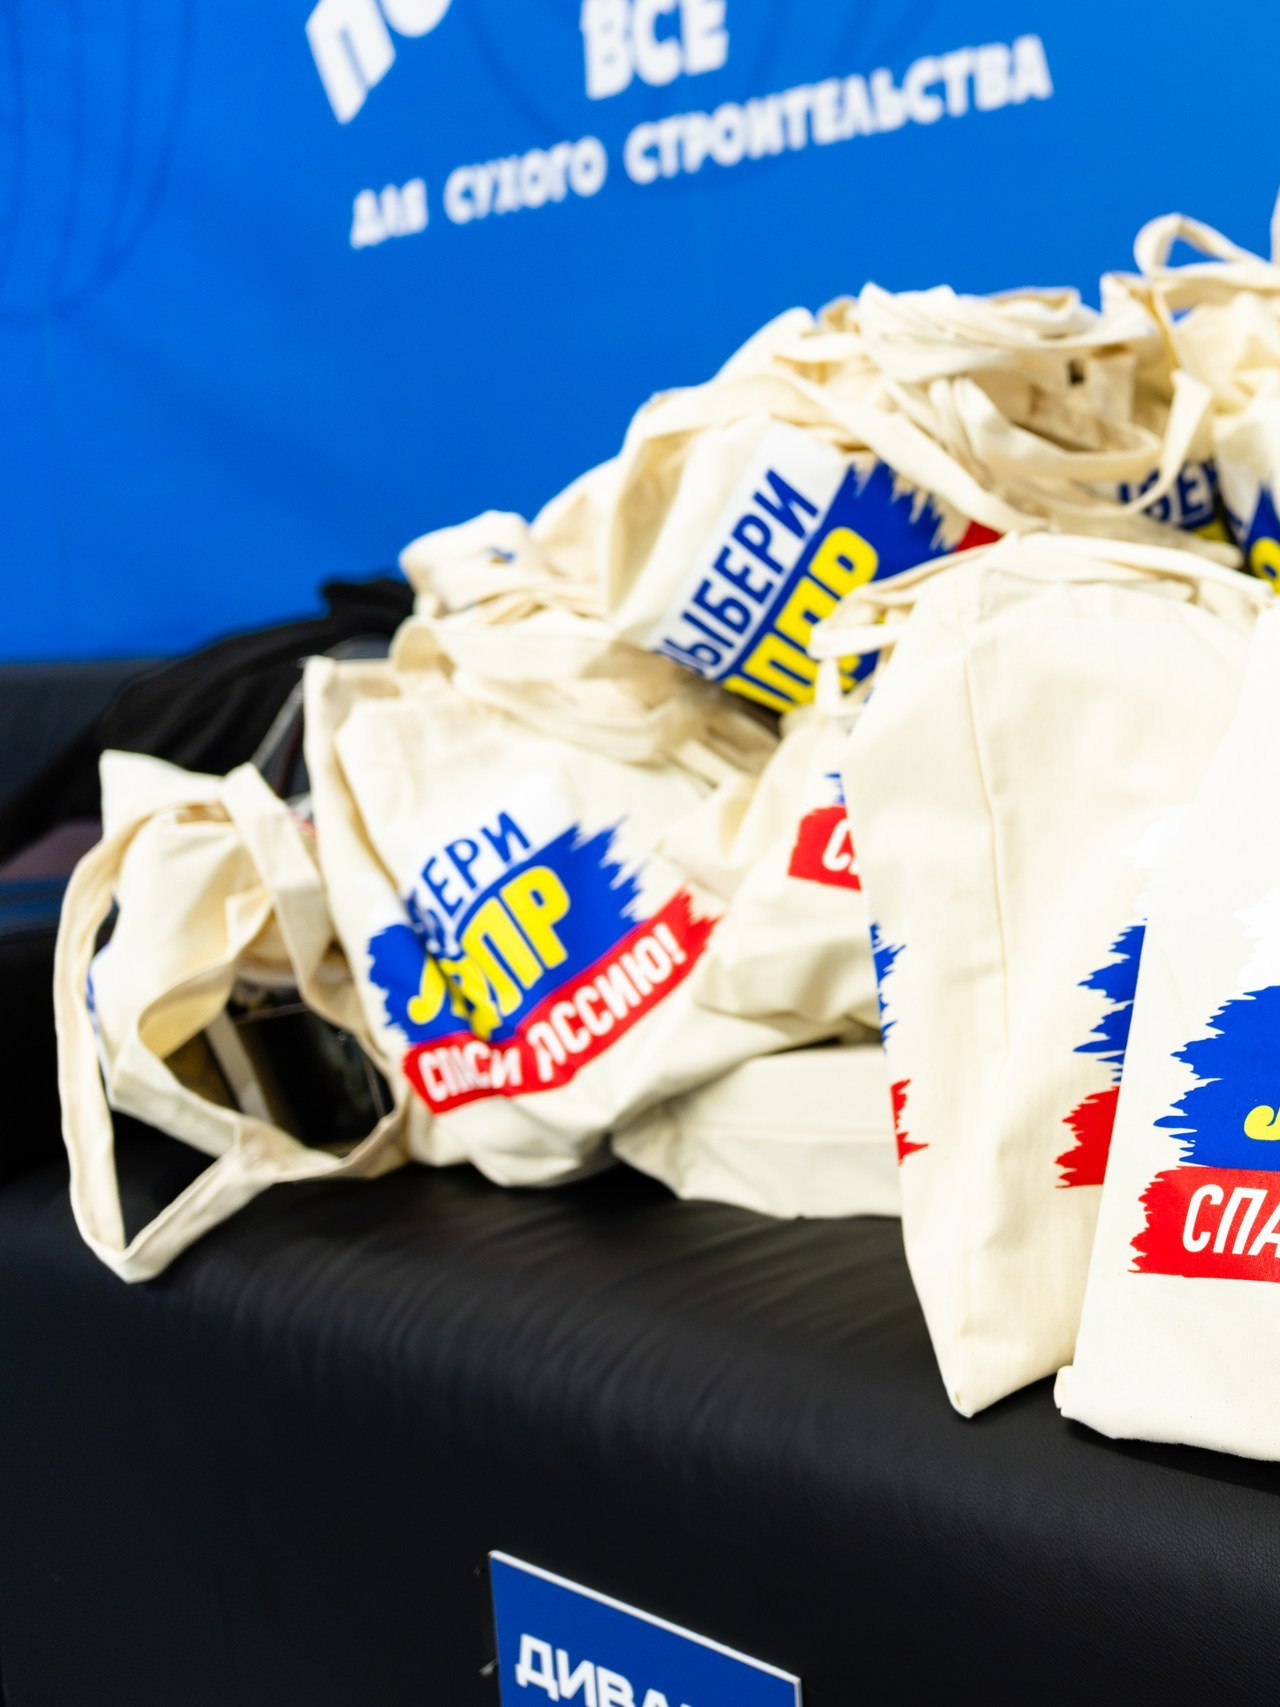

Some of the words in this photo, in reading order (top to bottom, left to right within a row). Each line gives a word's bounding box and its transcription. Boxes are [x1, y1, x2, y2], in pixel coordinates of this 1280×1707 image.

[442, 135, 608, 226] СУХОГО
[622, 34, 1053, 186] СТРОИТЕЛЬСТВА
[580, 0, 730, 101] ВСЕ
[656, 468, 819, 676] ЫБЕРИ
